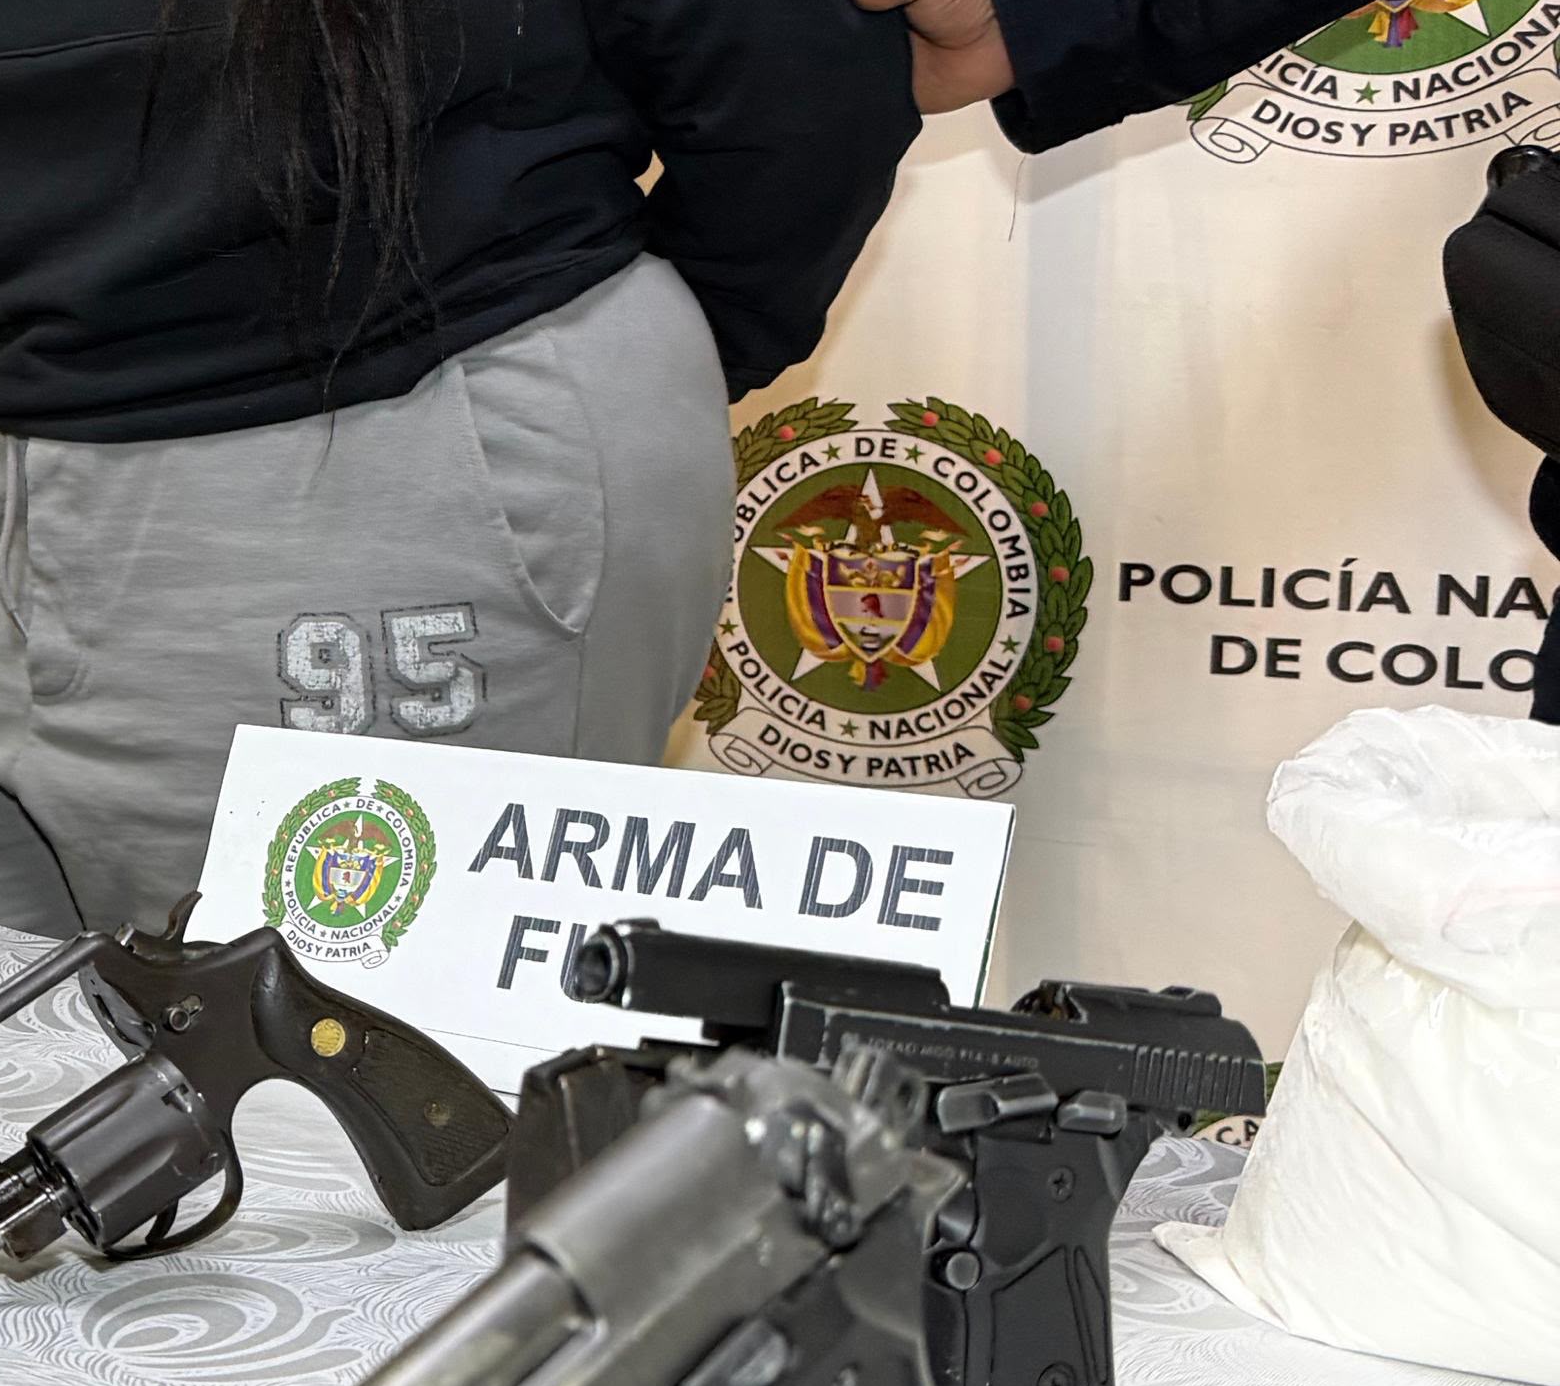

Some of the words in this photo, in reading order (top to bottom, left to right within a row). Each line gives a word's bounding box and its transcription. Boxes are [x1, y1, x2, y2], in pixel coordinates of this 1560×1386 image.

[1389, 91, 1532, 146] PATRIA
[855, 437, 897, 459] DE
[932, 456, 1030, 619] COLOMBIA
[1118, 557, 1412, 613] POLICÍA
[278, 601, 489, 736] 95
[1209, 634, 1303, 680] DE
[1325, 640, 1540, 692] COLO
[868, 658, 1013, 741] NACIONAL
[866, 741, 975, 778] PATRIA
[356, 798, 374, 811] DE
[385, 811, 414, 888] COLOMBIA
[468, 802, 764, 910] ARMA
[798, 835, 955, 932] DE
[325, 942, 371, 957] PATRIA
[331, 903, 397, 940] NACIONAL
